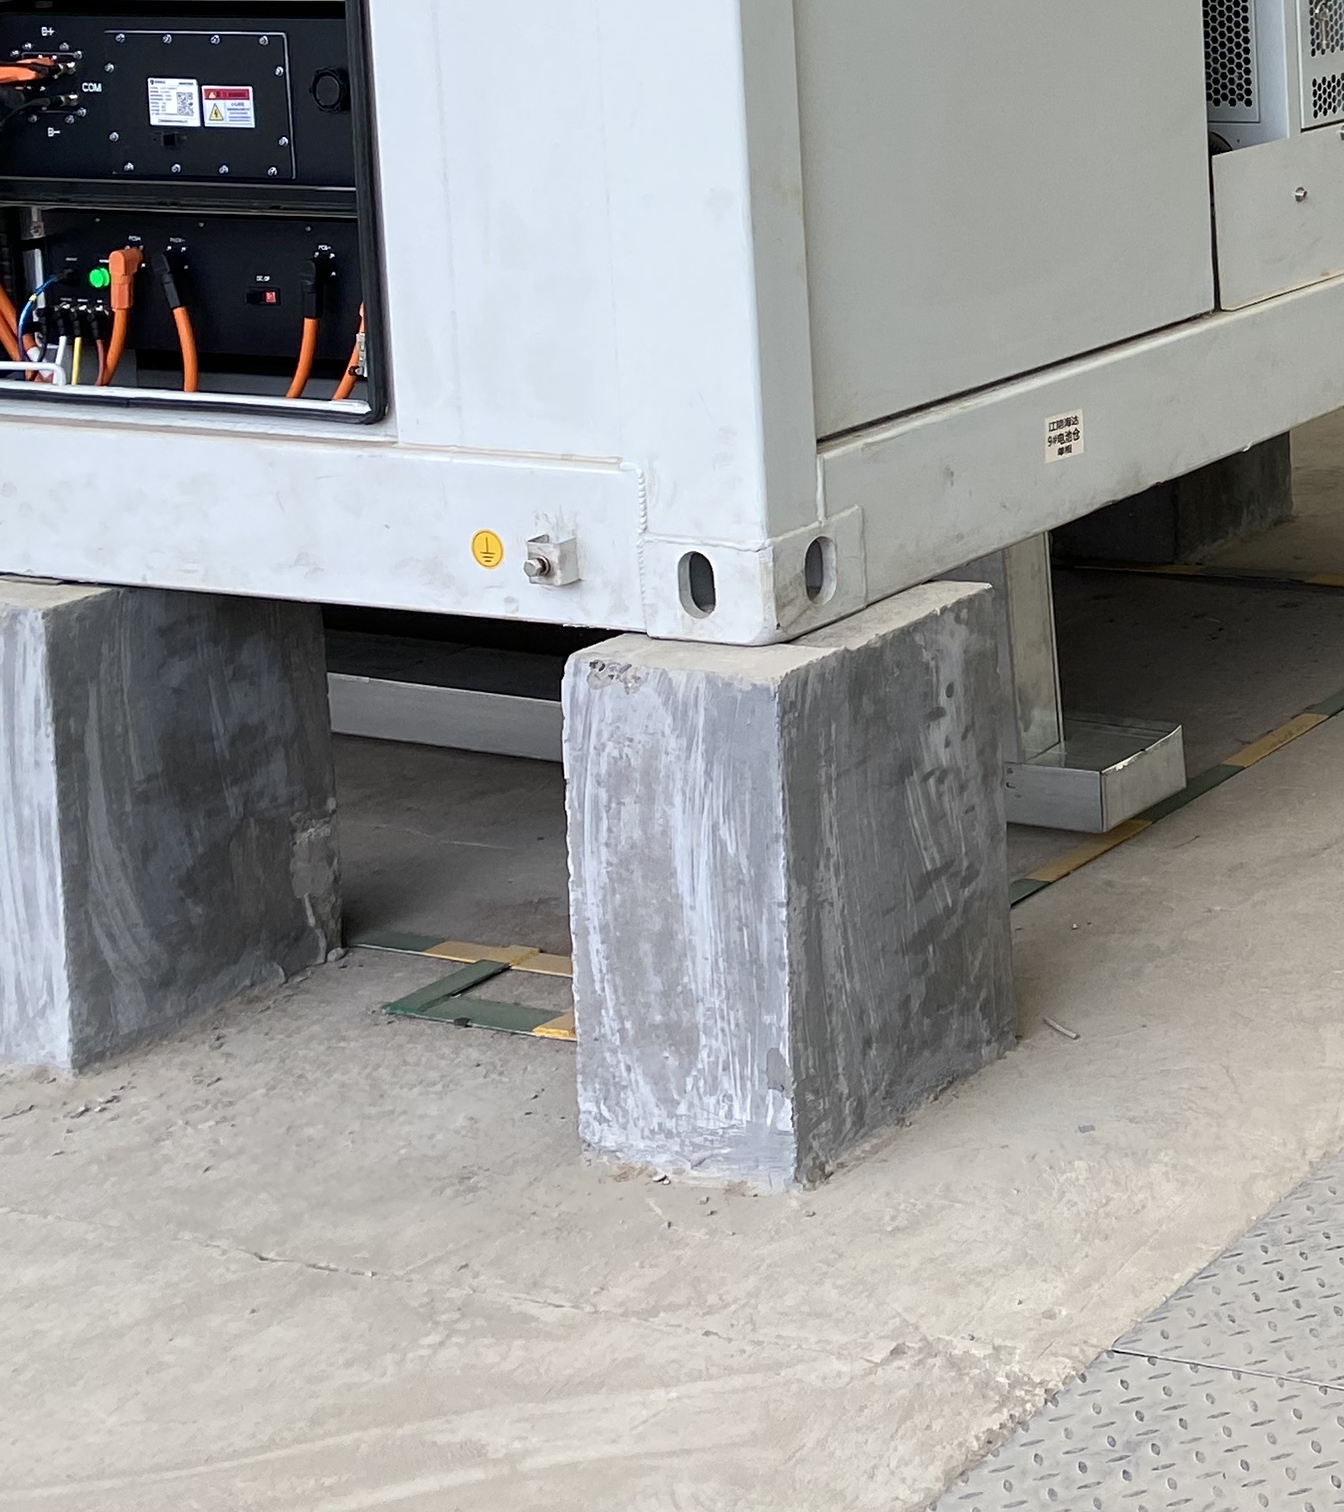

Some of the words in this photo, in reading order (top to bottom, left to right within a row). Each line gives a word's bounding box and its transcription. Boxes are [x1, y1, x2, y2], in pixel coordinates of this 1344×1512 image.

[82, 82, 102, 92] COM
[1047, 427, 1080, 448] 9#电池仓
